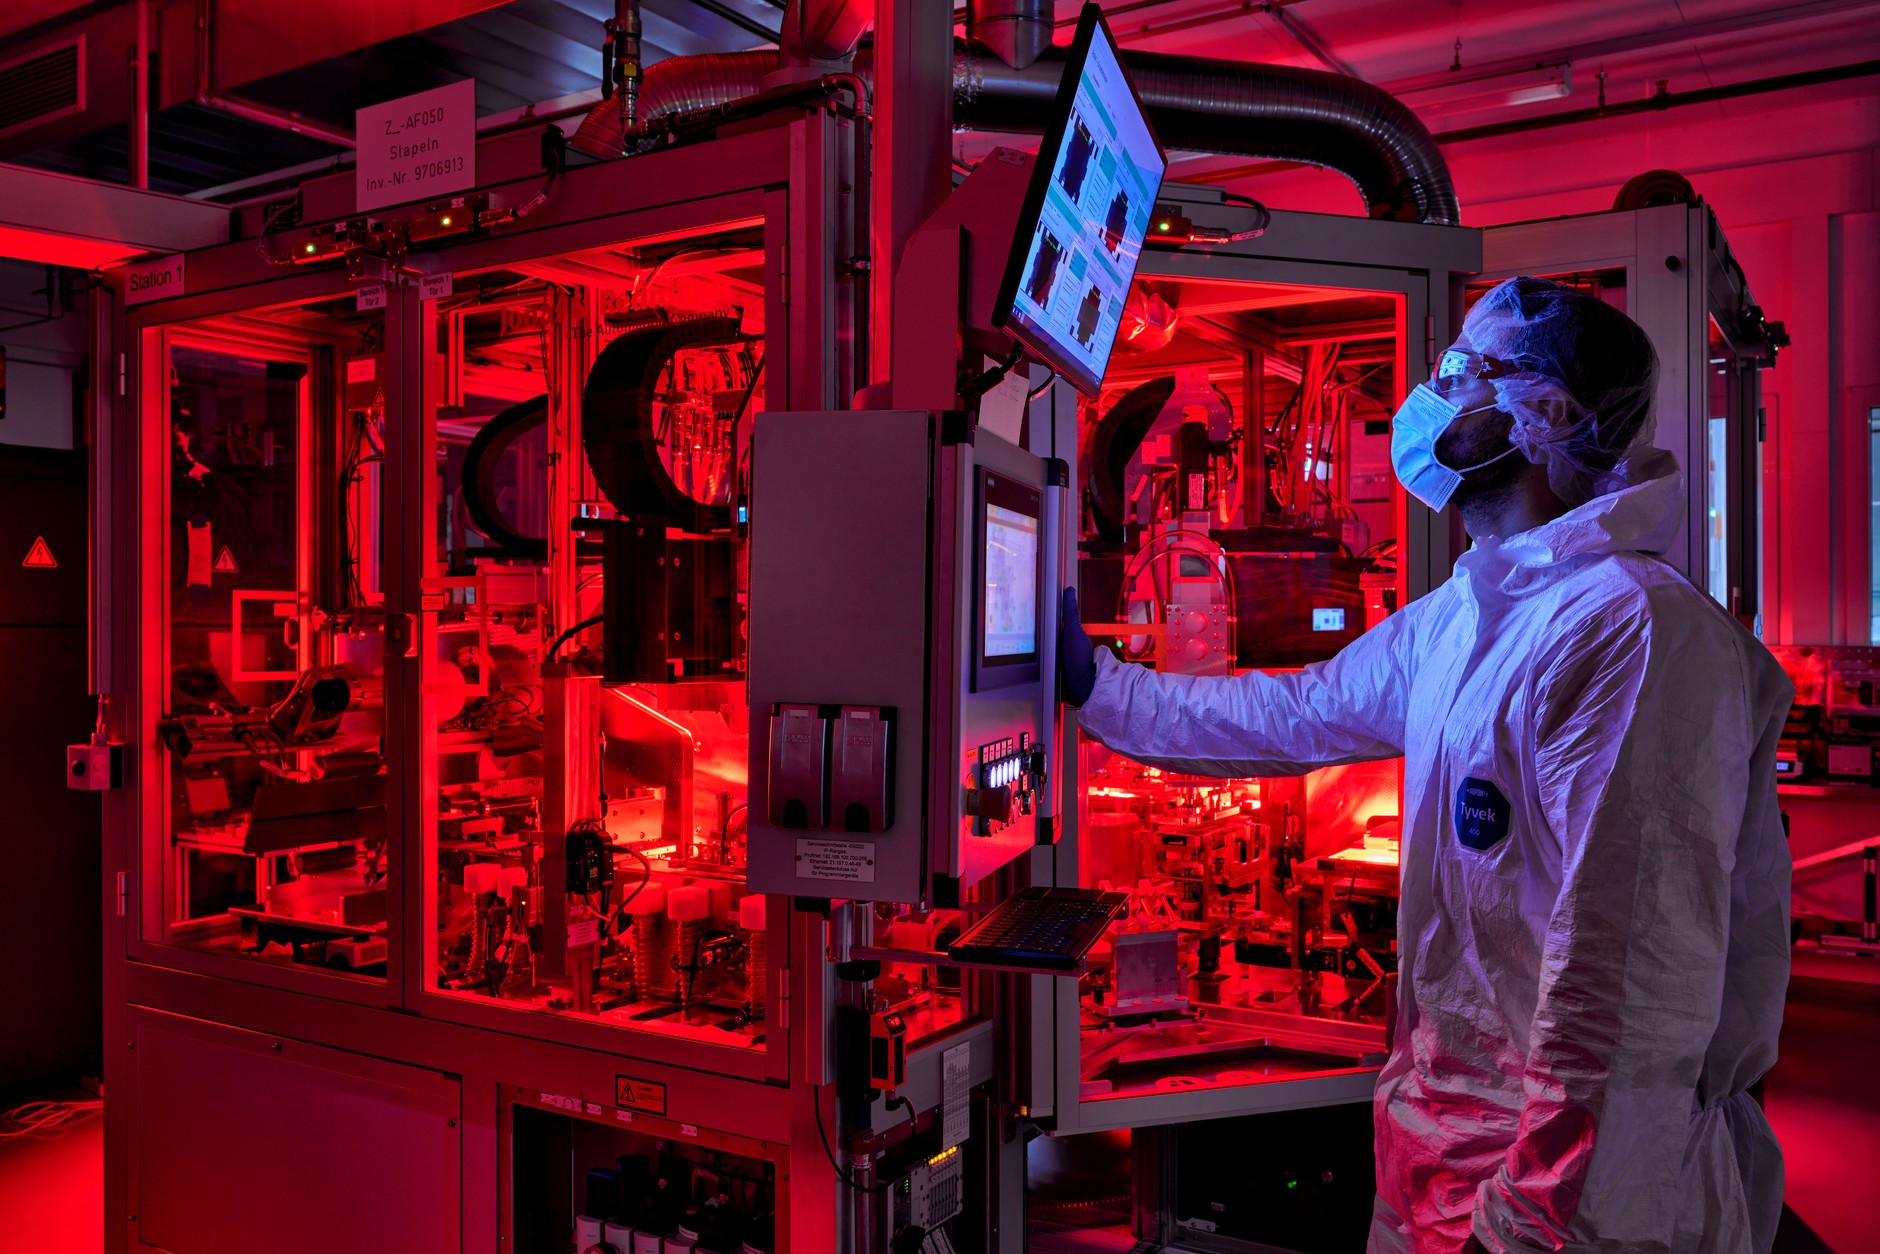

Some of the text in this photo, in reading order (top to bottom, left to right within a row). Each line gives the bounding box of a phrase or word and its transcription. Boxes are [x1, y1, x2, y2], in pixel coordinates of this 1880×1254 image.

[385, 107, 444, 135] Z_-AF050
[390, 138, 438, 160] Stapeln
[366, 156, 464, 192] Inv.-Nr. 9706913
[130, 263, 182, 292] Station 1
[423, 276, 444, 286] Bereich
[360, 286, 380, 298] Bereich
[429, 286, 439, 296] Tür
[365, 297, 380, 307] Tür 2
[671, 308, 731, 325] Company
[1461, 801, 1496, 823] Tyvek
[1469, 827, 1480, 837] 400
